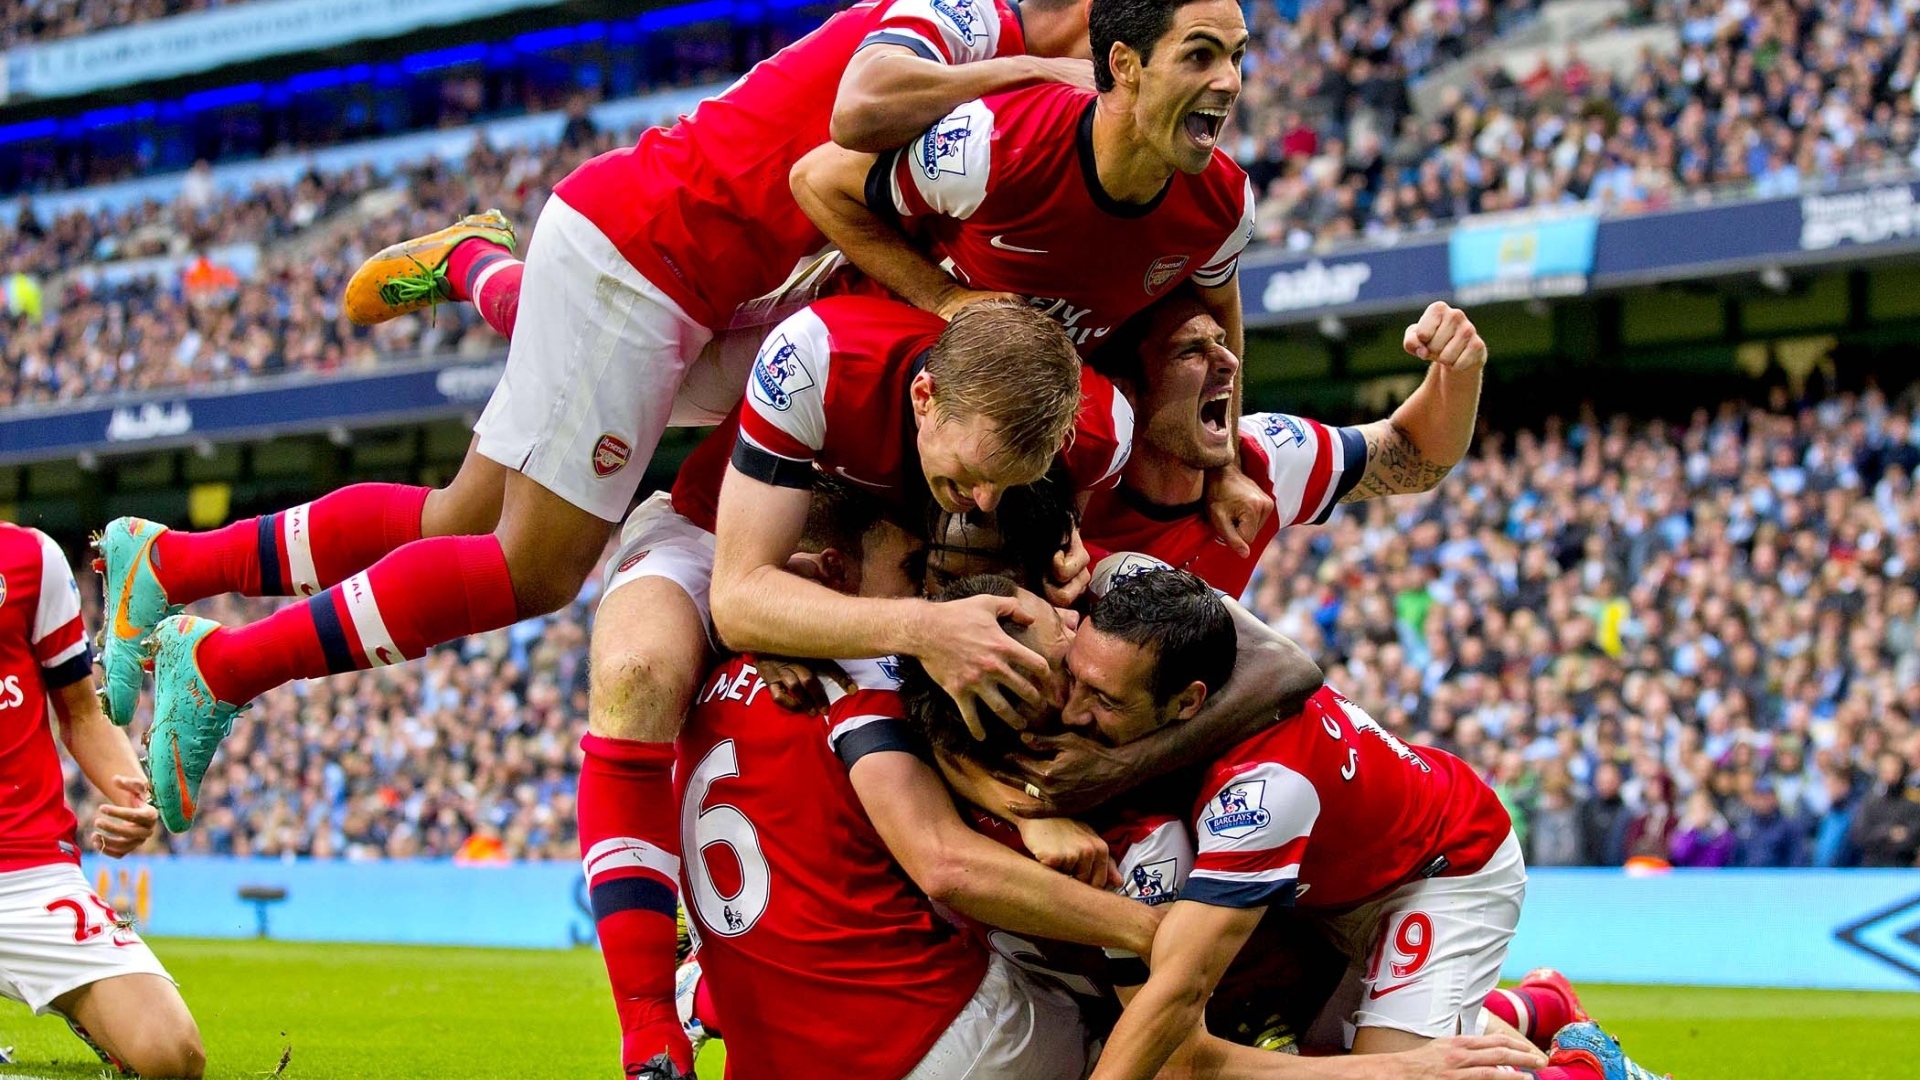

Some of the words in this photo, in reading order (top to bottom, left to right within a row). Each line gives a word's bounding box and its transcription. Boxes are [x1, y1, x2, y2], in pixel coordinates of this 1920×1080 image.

[1155, 261, 1184, 270] Arsenal
[757, 362, 779, 394] BARCLAYS
[602, 438, 628, 456] Arsenal
[1213, 812, 1252, 827] BARCLAYS
